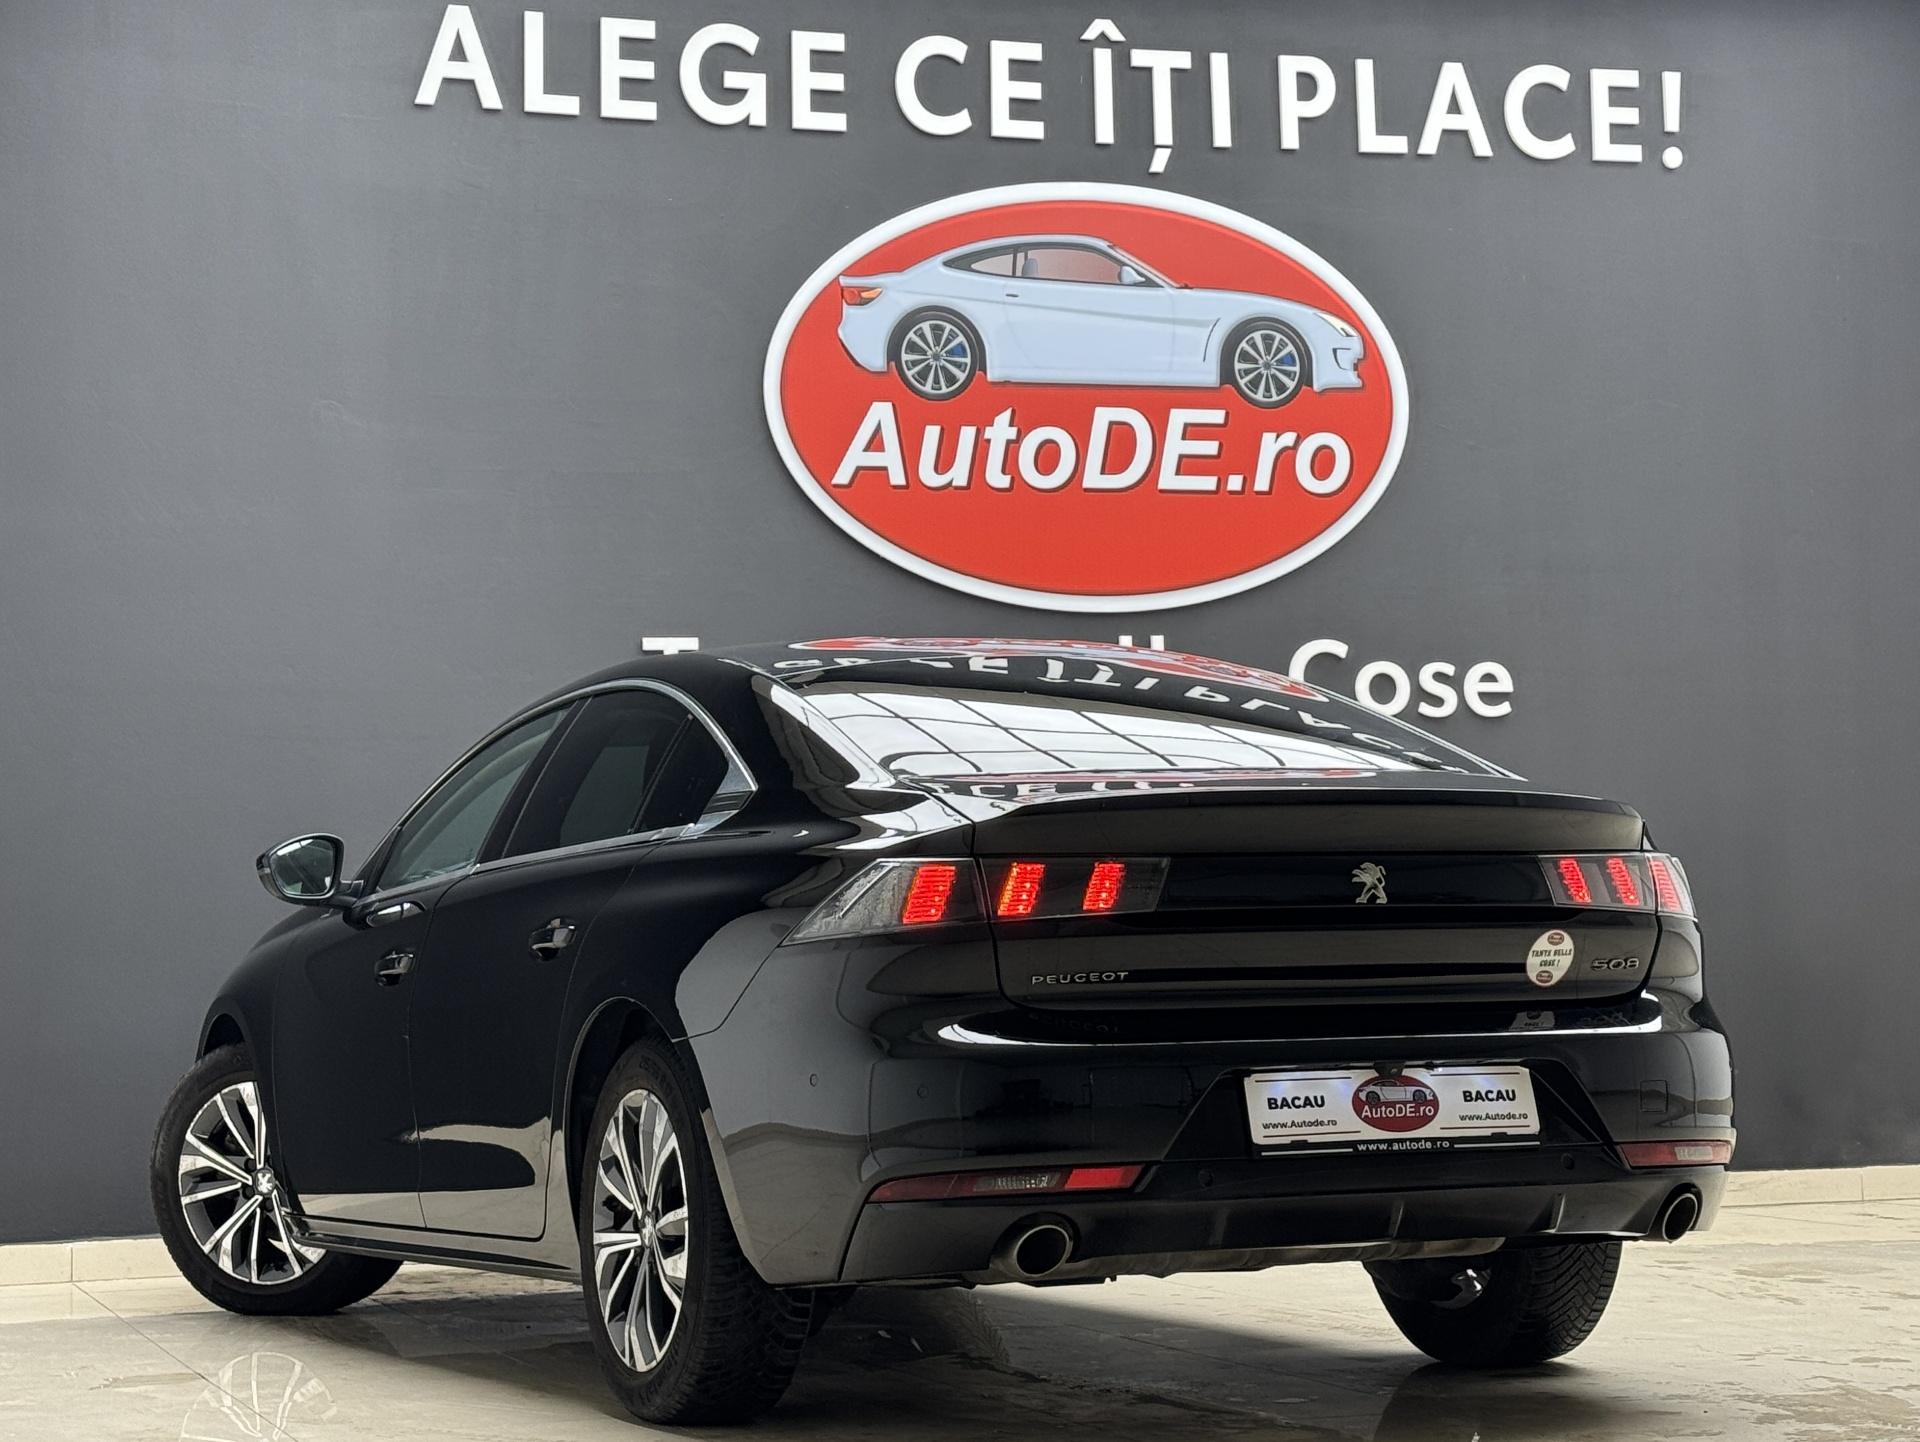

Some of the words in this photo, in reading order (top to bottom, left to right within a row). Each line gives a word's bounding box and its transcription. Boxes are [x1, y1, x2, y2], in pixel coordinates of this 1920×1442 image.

[414, 4, 848, 132] ALEGE
[895, 35, 1045, 140] CE
[1277, 54, 1685, 169] PLACE!
[831, 401, 1352, 494] AutoDE.ro
[1288, 638, 1515, 719] Cose
[1591, 957, 1640, 970] 508
[1031, 971, 1129, 985] PEUGEOT
[1266, 1094, 1326, 1110] BACAU
[1461, 1089, 1517, 1102] BACAU
[1361, 1103, 1435, 1119] AutoDE.ro
[1458, 1111, 1529, 1121] www.Autode.ro
[1261, 1118, 1338, 1130] www.Autode.ro
[1356, 1139, 1451, 1152] www.autode.ro
